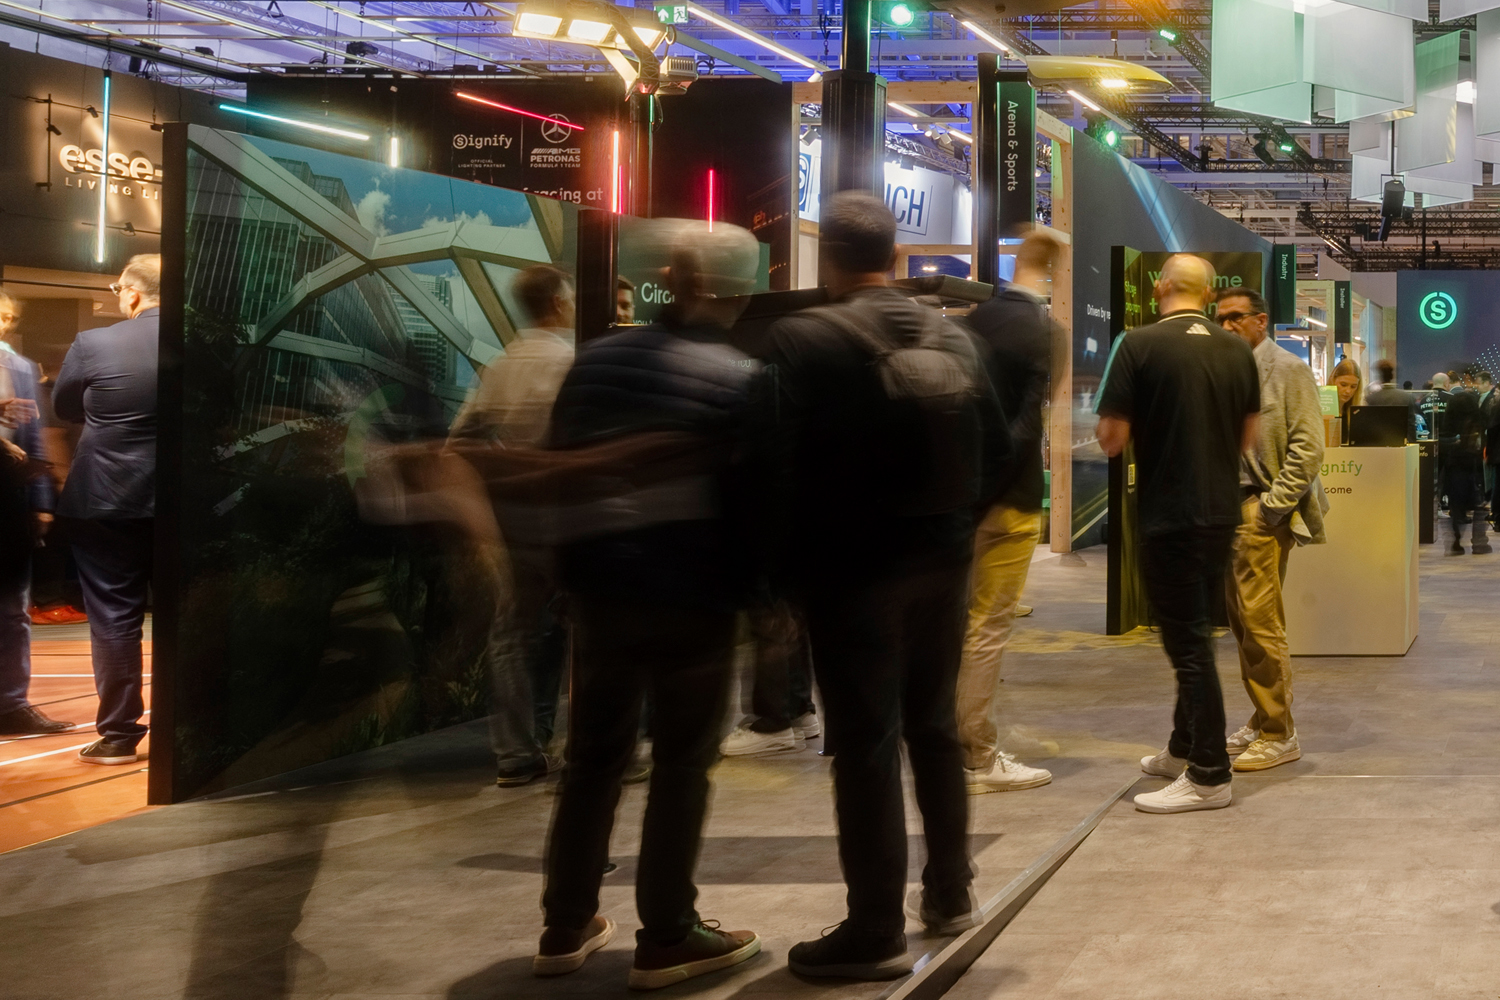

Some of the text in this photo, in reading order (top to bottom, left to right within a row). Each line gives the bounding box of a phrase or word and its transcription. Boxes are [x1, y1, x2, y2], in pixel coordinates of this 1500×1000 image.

[1004, 100, 1019, 192] Arena & Sports
[530, 155, 581, 163] PETRONAS
[65, 176, 132, 196] LIVNG
[586, 187, 604, 201] at
[1280, 253, 1289, 280] Industry
